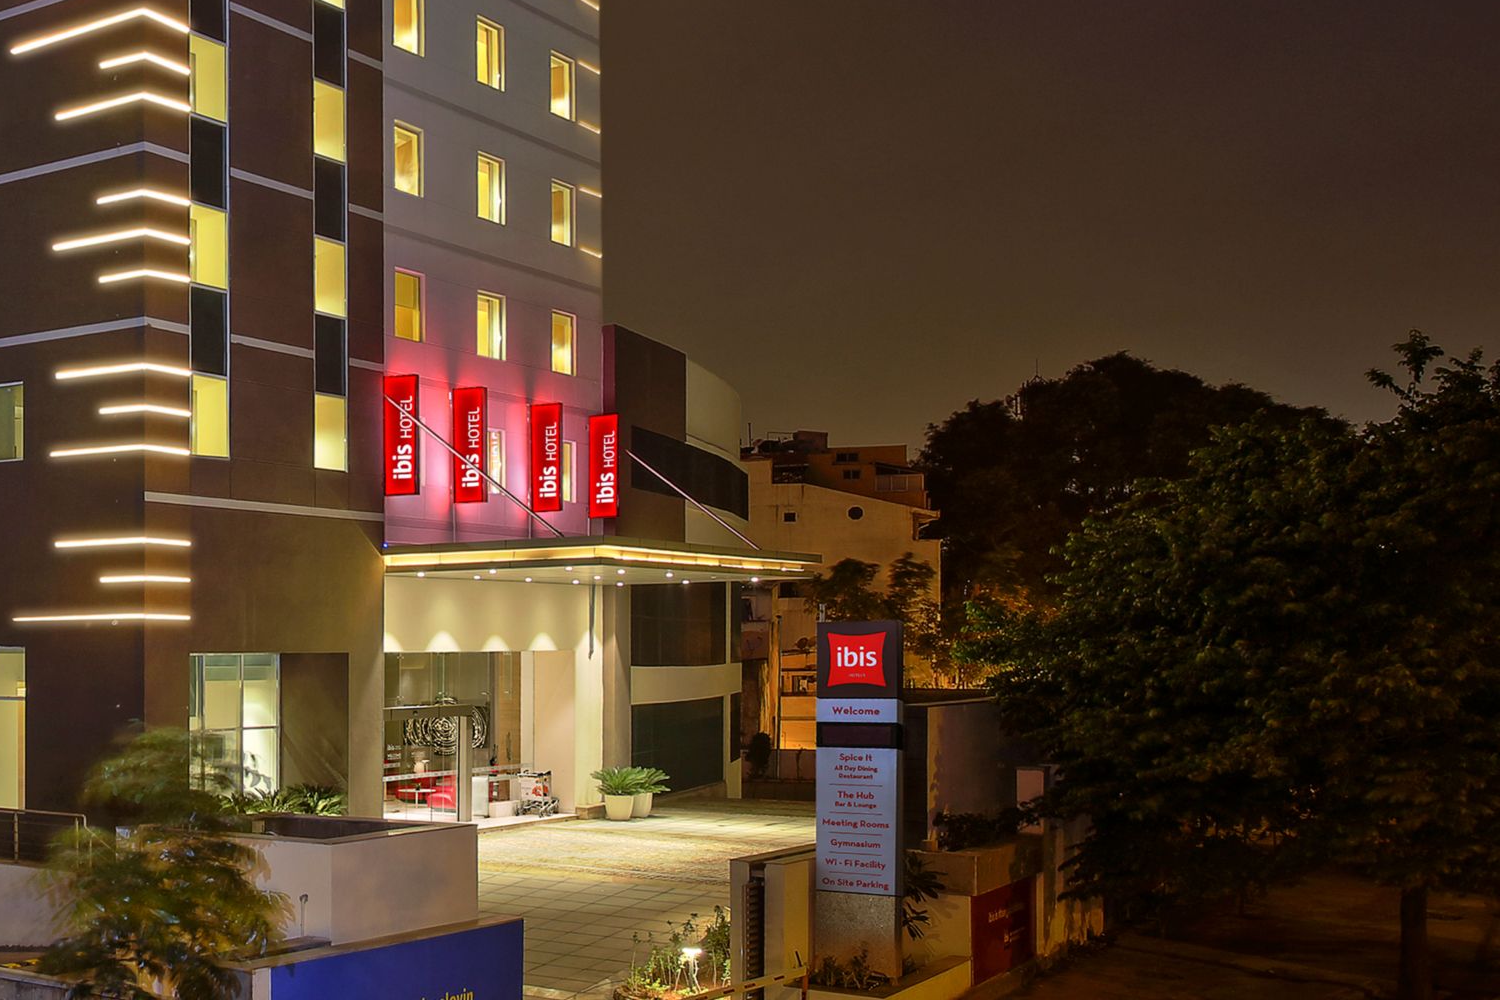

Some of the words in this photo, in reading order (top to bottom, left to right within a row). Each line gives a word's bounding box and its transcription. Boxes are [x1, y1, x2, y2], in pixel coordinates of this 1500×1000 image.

[468, 406, 480, 448] HOTEL
[545, 421, 557, 461] HOTEL
[603, 430, 615, 468] HOTEL
[392, 444, 413, 480] ibis
[461, 453, 480, 488] ibis
[539, 465, 557, 498] ibis
[596, 472, 615, 504] ibis
[836, 646, 878, 668] ibis
[832, 706, 880, 716] Welcome
[839, 753, 864, 762] Spice
[857, 765, 878, 773] Dining
[837, 790, 854, 799] The
[856, 791, 875, 800] Hub
[822, 819, 858, 829] Meeting
[860, 820, 890, 829] Rooms
[830, 839, 881, 849] Gymnasium
[854, 860, 886, 870] Facility
[821, 877, 836, 886] On
[836, 879, 854, 887] Site
[856, 880, 890, 891] Parking
